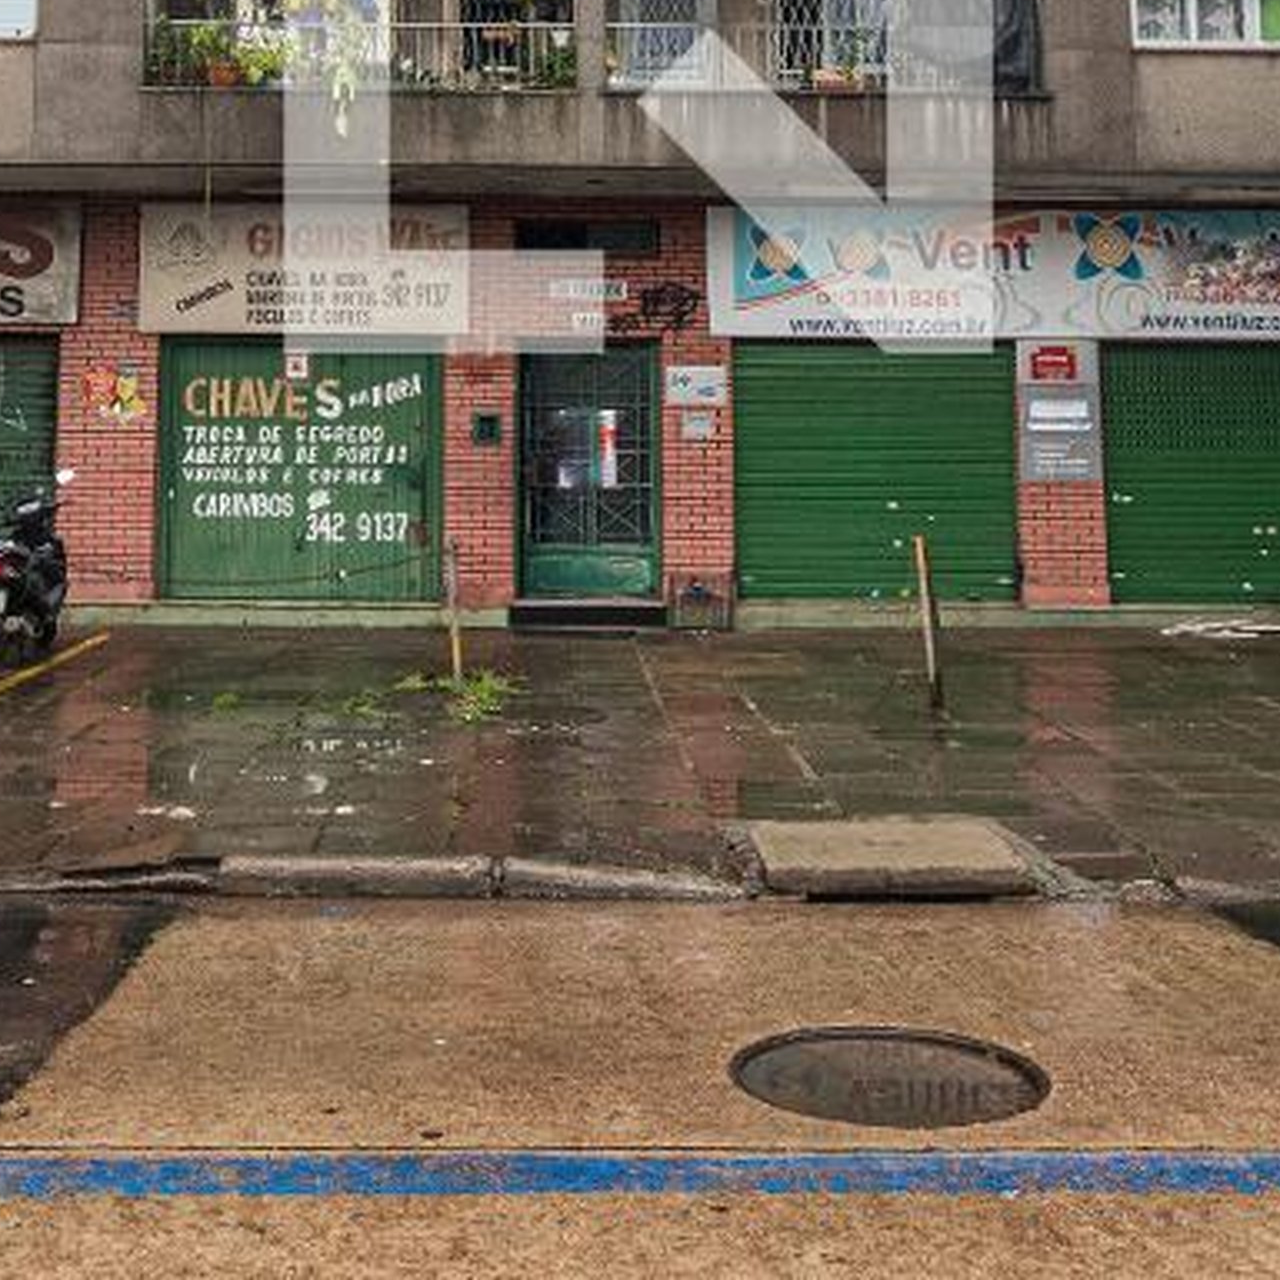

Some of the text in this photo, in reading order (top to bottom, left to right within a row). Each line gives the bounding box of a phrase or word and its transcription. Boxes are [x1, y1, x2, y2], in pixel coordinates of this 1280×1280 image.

[183, 376, 344, 419] CHAVES
[182, 425, 386, 444] TROCA DE SEGREDO
[182, 445, 283, 465] ABERTURA
[293, 445, 319, 465] DE
[305, 511, 409, 543] 342 9137
